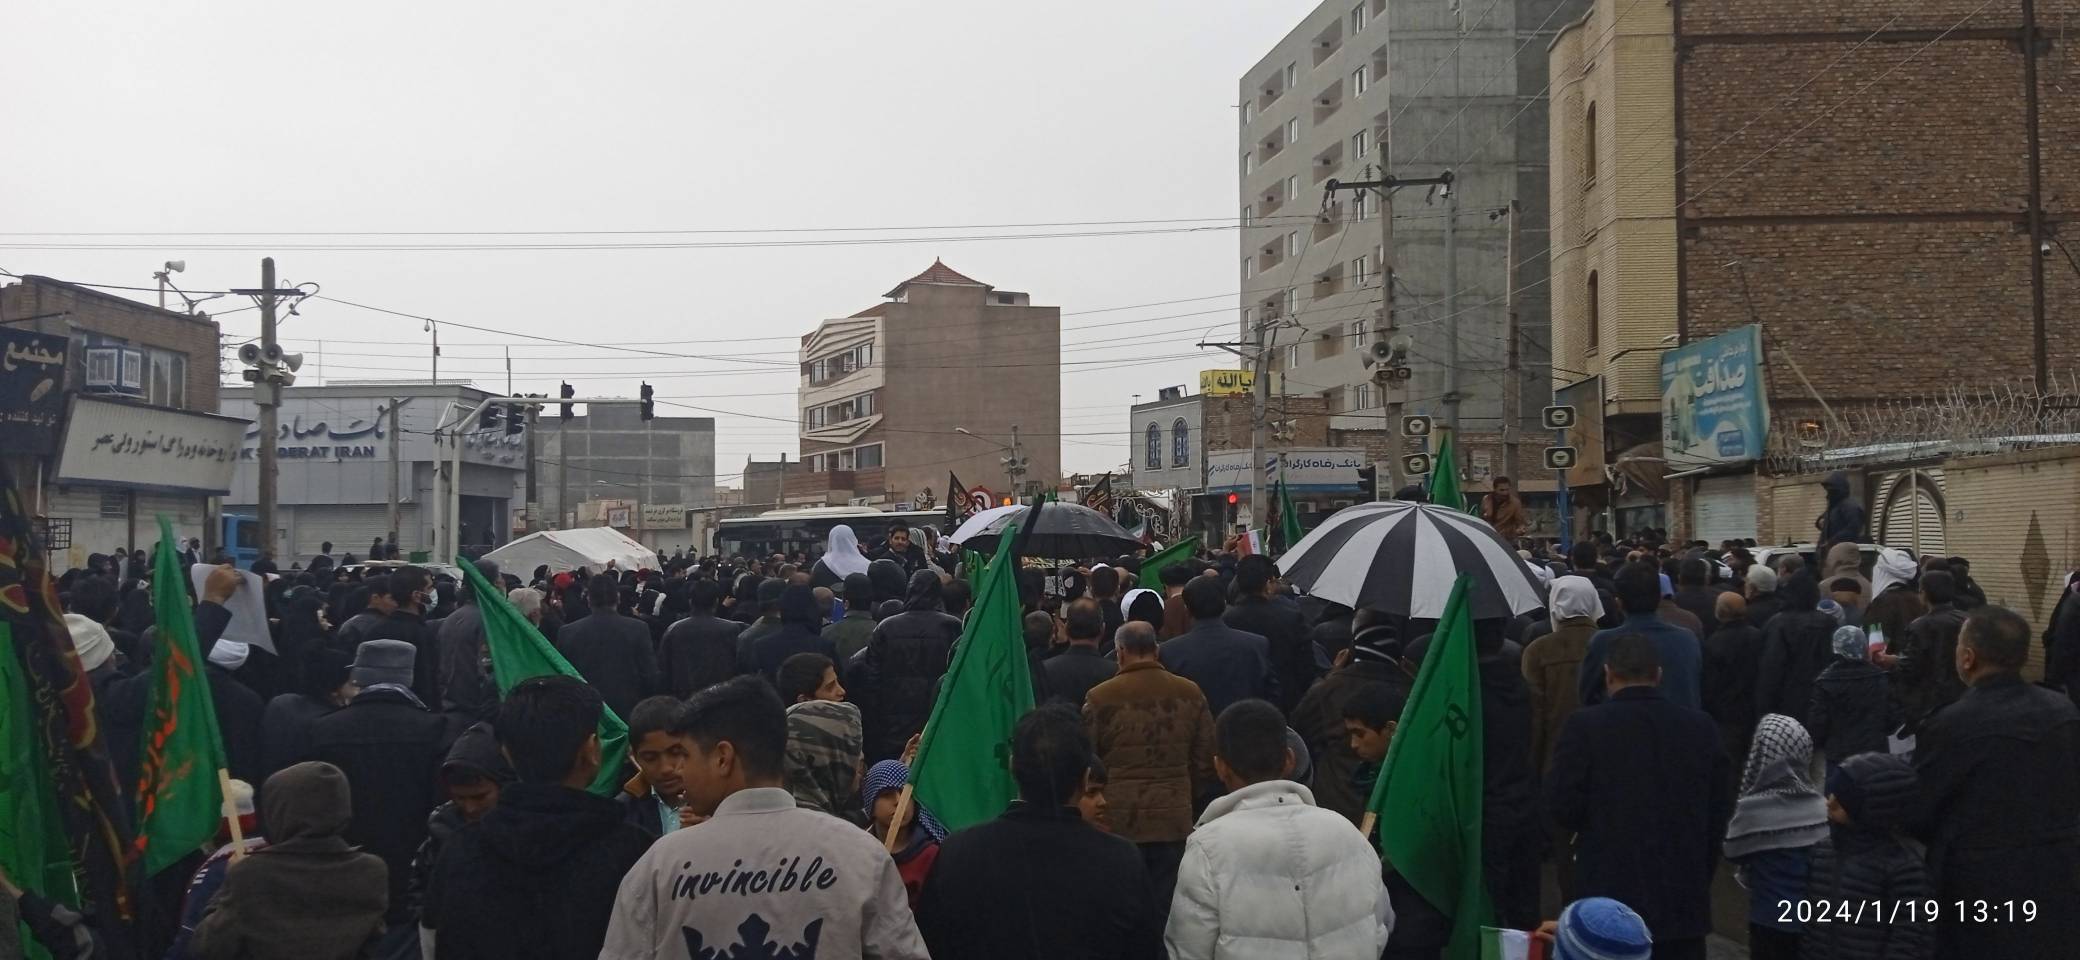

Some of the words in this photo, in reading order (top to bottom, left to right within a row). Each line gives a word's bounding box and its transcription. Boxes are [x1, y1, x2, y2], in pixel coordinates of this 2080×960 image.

[4, 340, 63, 371] مجتمع
[1694, 358, 1746, 397] صداقت
[334, 446, 375, 458] IRAN
[1336, 457, 1361, 468] بانک
[1312, 457, 1335, 470] رفاه
[671, 855, 838, 901] invincible
